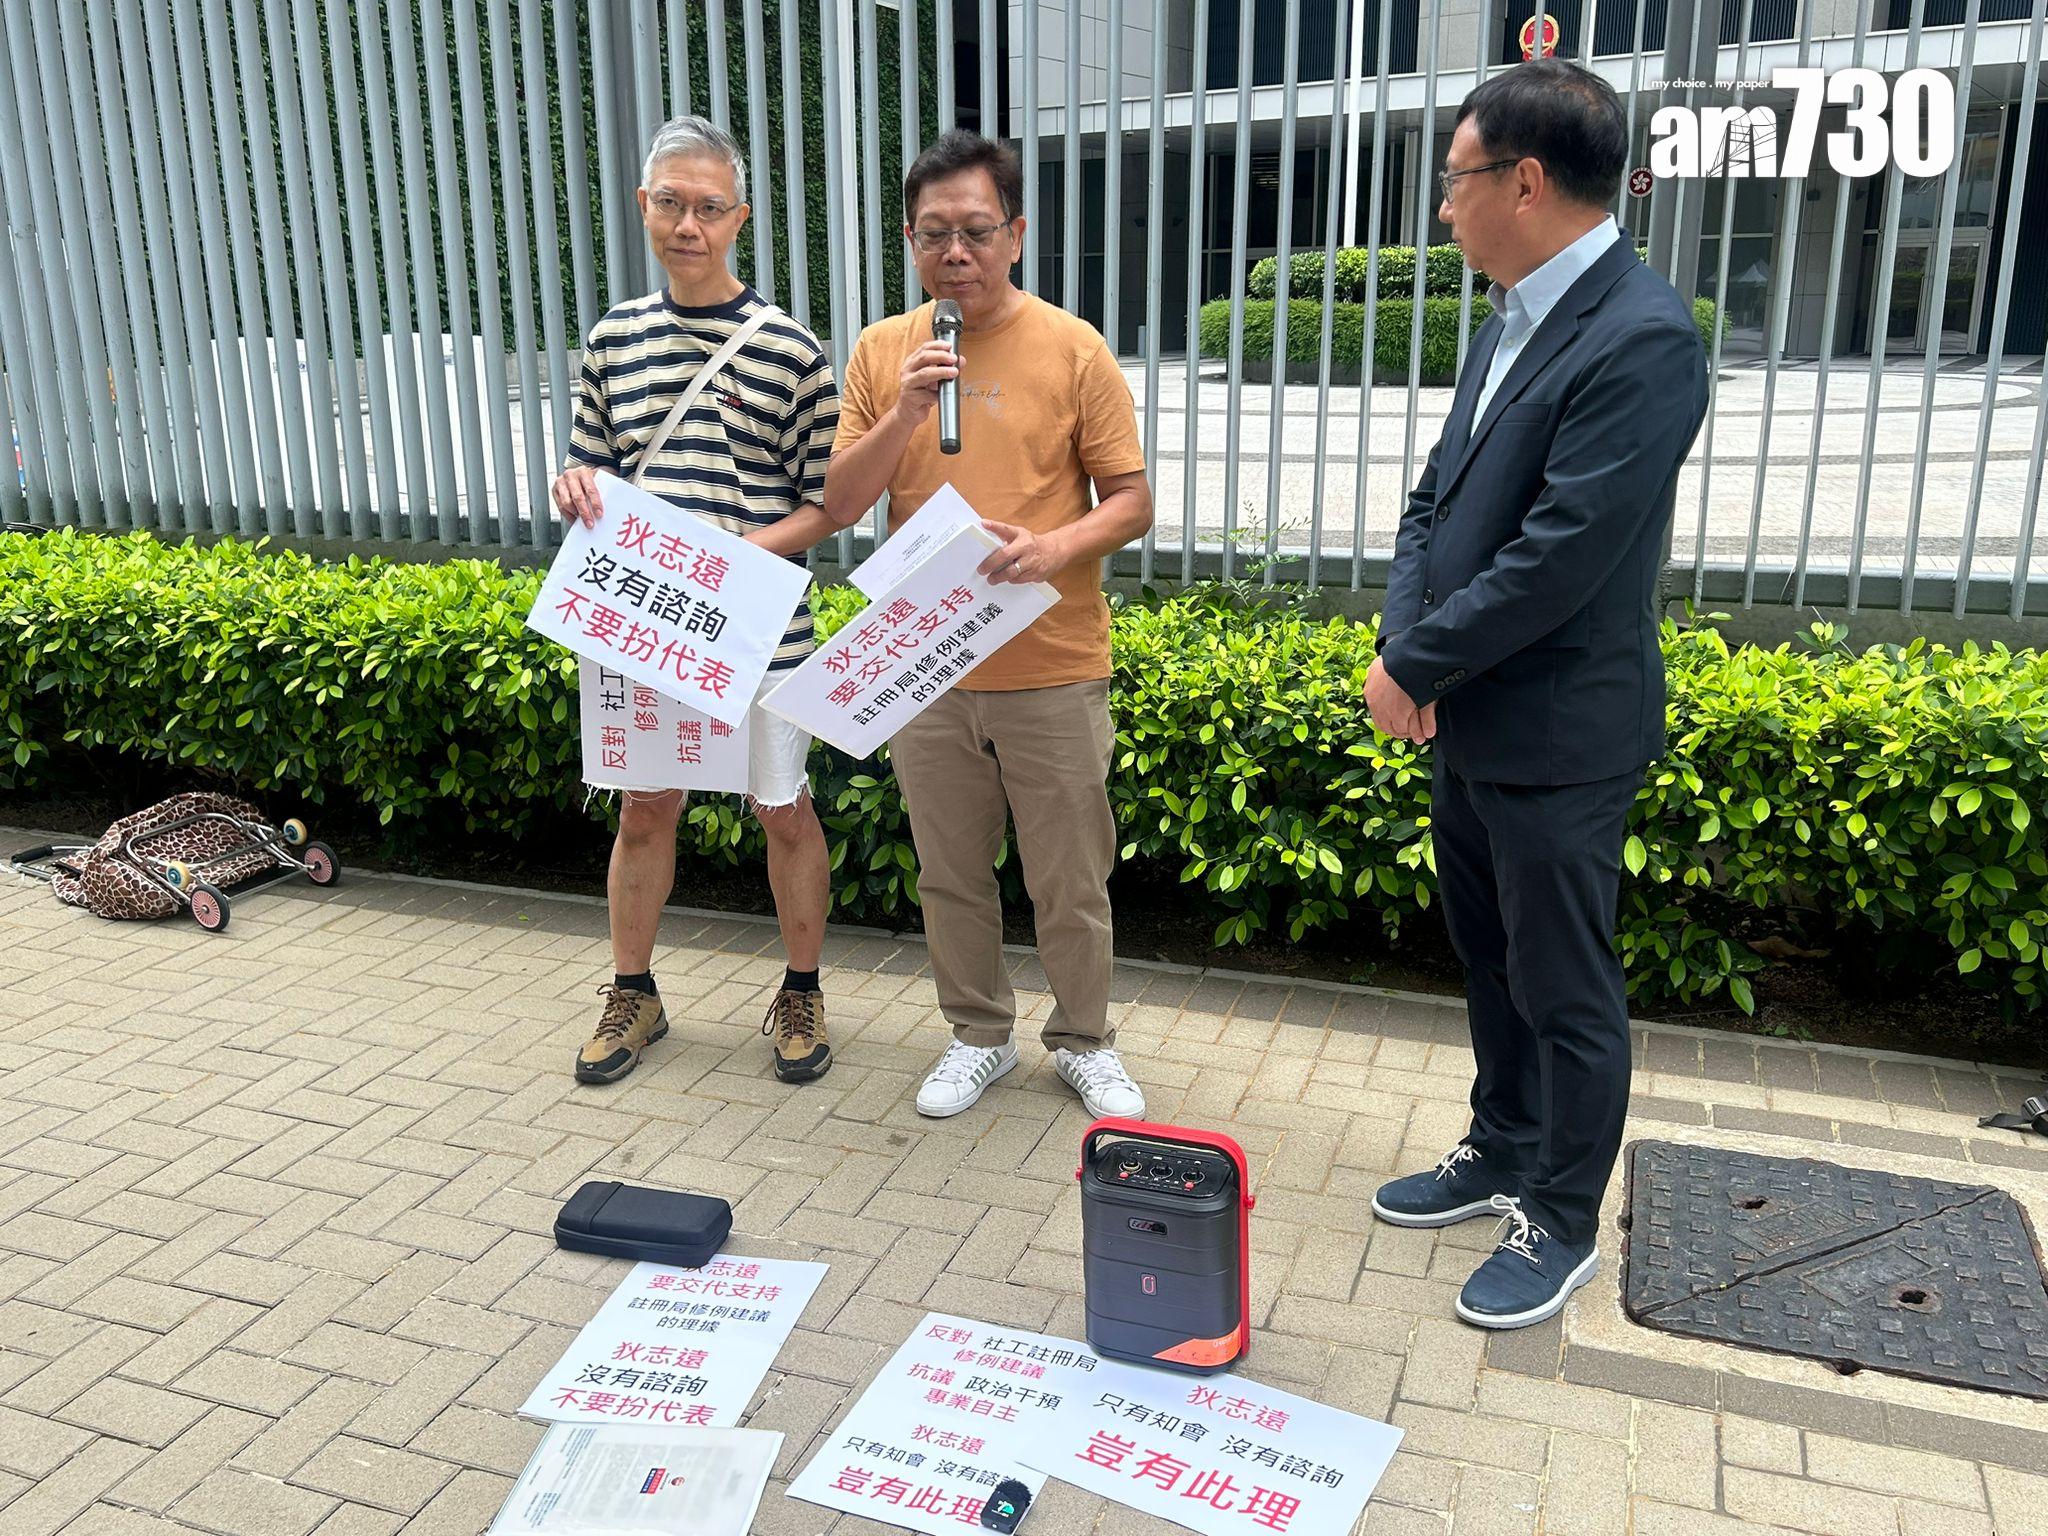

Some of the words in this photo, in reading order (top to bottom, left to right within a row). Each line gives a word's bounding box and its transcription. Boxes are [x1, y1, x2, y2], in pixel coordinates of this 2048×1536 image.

[616, 513, 730, 593] 狄志遠
[577, 547, 728, 643] 沒有諮詢
[555, 587, 735, 699] 不要扮代表
[822, 597, 918, 675] 狄志遠
[825, 585, 975, 708] 要交代支持
[852, 602, 1003, 726] 註冊局修例建議
[911, 648, 978, 703] 的理據
[600, 666, 625, 712] 社工
[601, 725, 627, 770] 反對
[677, 720, 701, 764] 抗議
[627, 1296, 771, 1323] 註冊局修例建議
[646, 1274, 783, 1302] 要交代支持
[656, 1316, 720, 1334] 的理據
[924, 1324, 973, 1345] 反對
[983, 1336, 1098, 1373] 社工註冊局
[574, 1363, 709, 1397] 沒有諮詢
[611, 1341, 709, 1370] 狄志遠
[953, 1348, 1047, 1380] 修例建議
[550, 1387, 718, 1427] 不要扮代表
[907, 1362, 956, 1385] 抗議
[964, 1375, 1064, 1411] 政治干預
[923, 1387, 1020, 1423] 專業自主
[1186, 1384, 1291, 1433] 狄志遠
[842, 1436, 928, 1469] 只有知會
[933, 1459, 1016, 1487] 沒有諮
[911, 1424, 986, 1455] 狄志遠
[1093, 1392, 1210, 1443] 只有知會
[1219, 1434, 1345, 1489] 沒有諮詢
[829, 1465, 987, 1527] 豈有此理
[1075, 1430, 1302, 1533] 豈有此理
